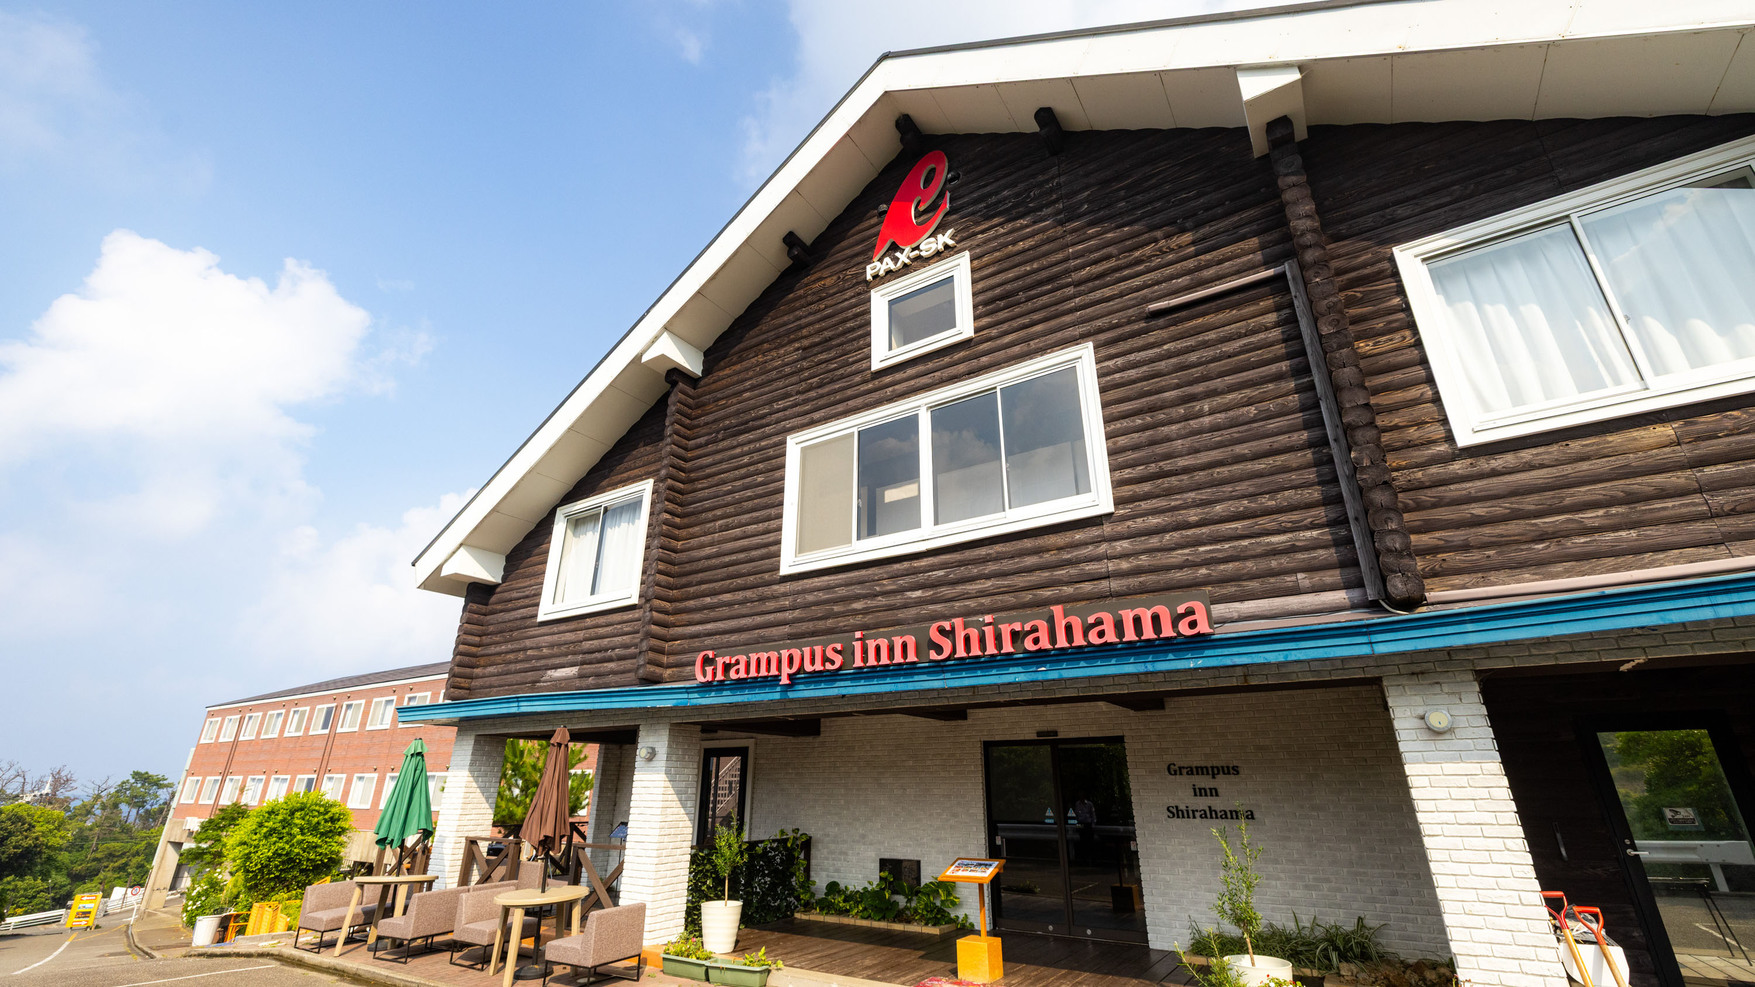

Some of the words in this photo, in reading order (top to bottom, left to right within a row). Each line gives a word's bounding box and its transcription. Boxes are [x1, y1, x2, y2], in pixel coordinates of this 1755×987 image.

[866, 228, 957, 282] PAX-SK
[695, 643, 843, 684] Grampus
[852, 631, 919, 668] inn
[929, 601, 1214, 661] Shirahama
[1166, 763, 1240, 779] Grampus
[1192, 784, 1220, 797] inn
[1166, 805, 1256, 820] Shirahama
